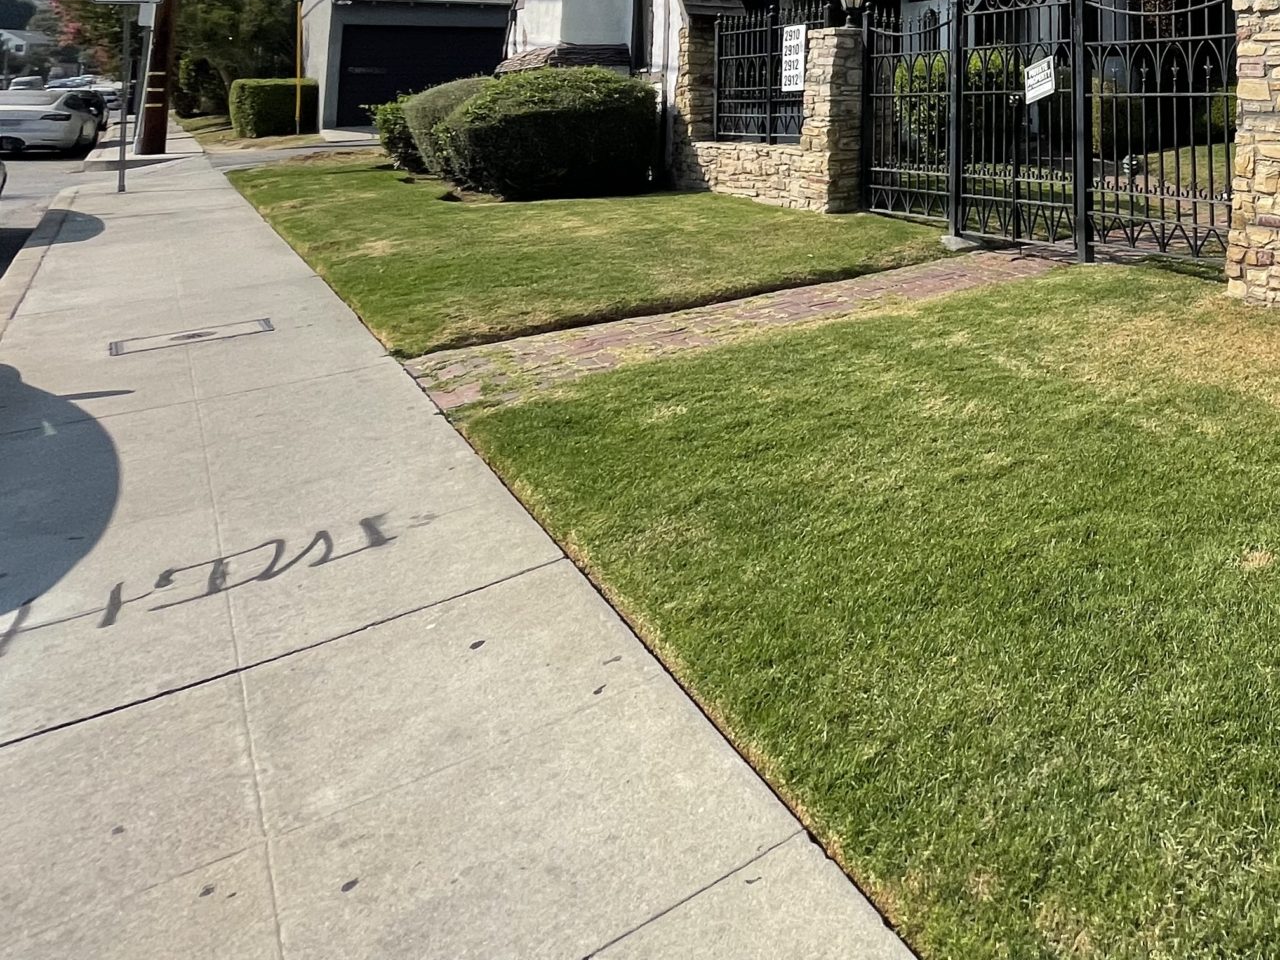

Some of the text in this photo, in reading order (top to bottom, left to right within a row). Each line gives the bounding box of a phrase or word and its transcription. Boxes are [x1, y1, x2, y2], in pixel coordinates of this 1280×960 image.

[784, 28, 801, 42] 2910
[783, 44, 800, 57] 2910
[783, 59, 799, 72] 2912
[783, 74, 799, 86] 2912
